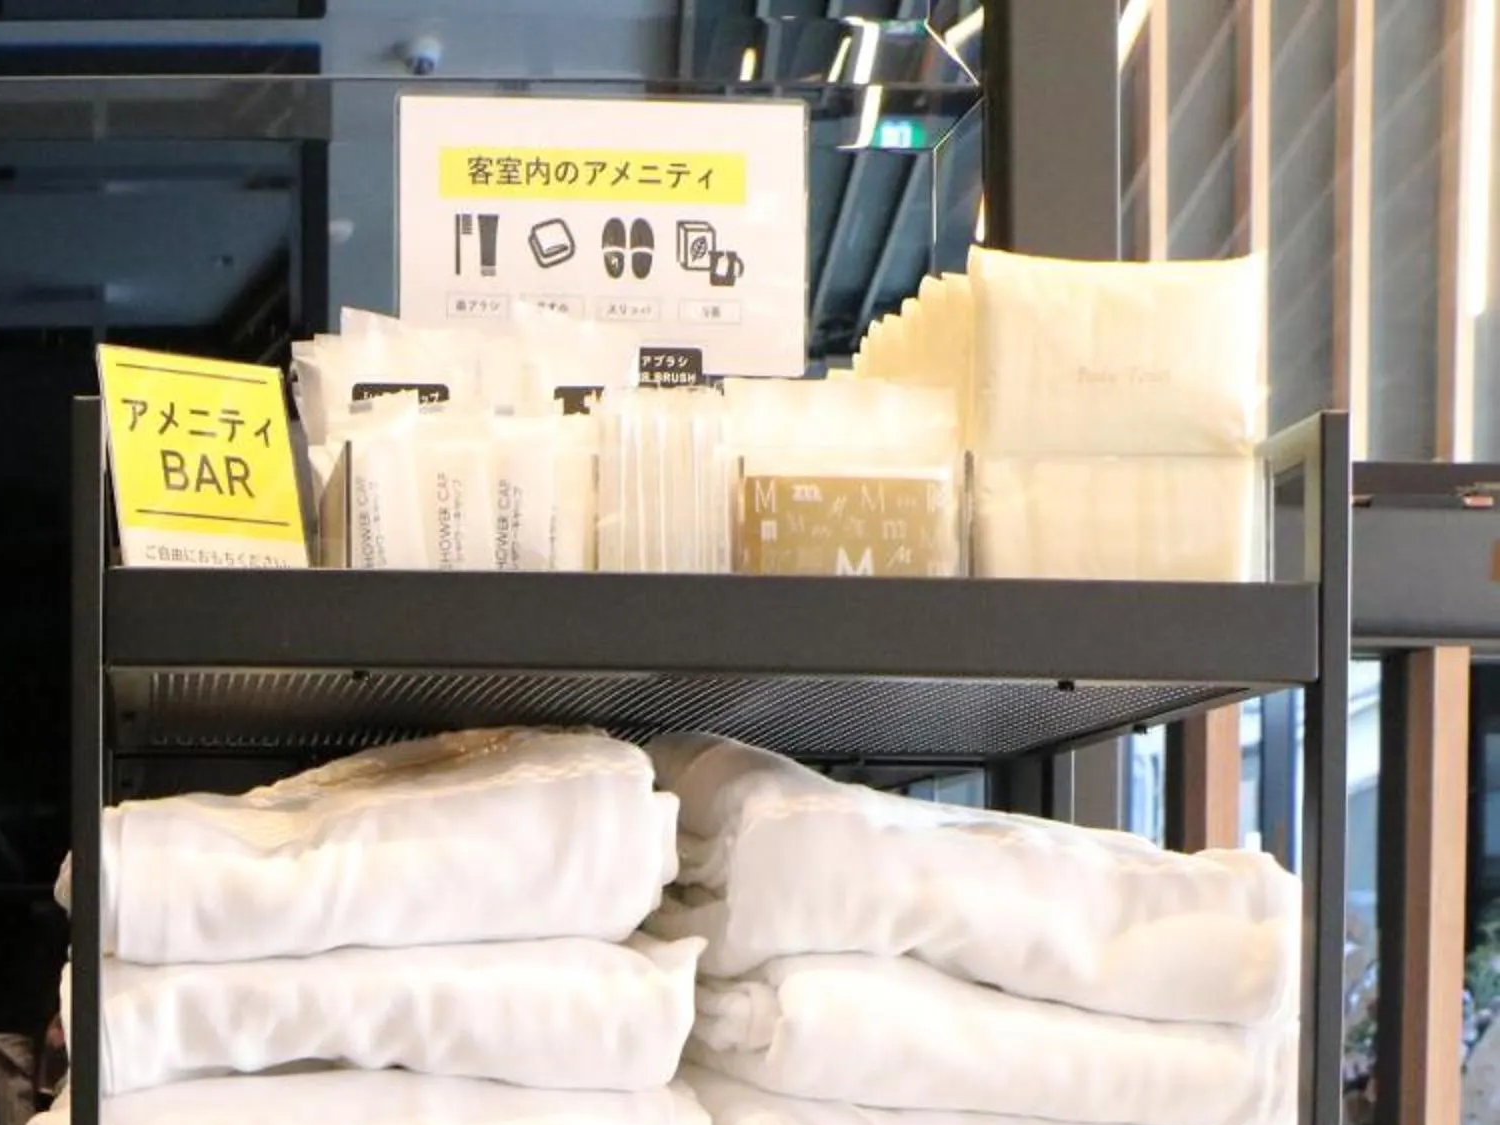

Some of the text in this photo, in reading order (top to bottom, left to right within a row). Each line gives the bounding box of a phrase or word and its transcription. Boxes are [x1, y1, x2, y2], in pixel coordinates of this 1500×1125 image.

[467, 155, 714, 191] 客室内のアメニティ
[120, 397, 272, 448] アメニティ
[160, 449, 256, 498] BAR
